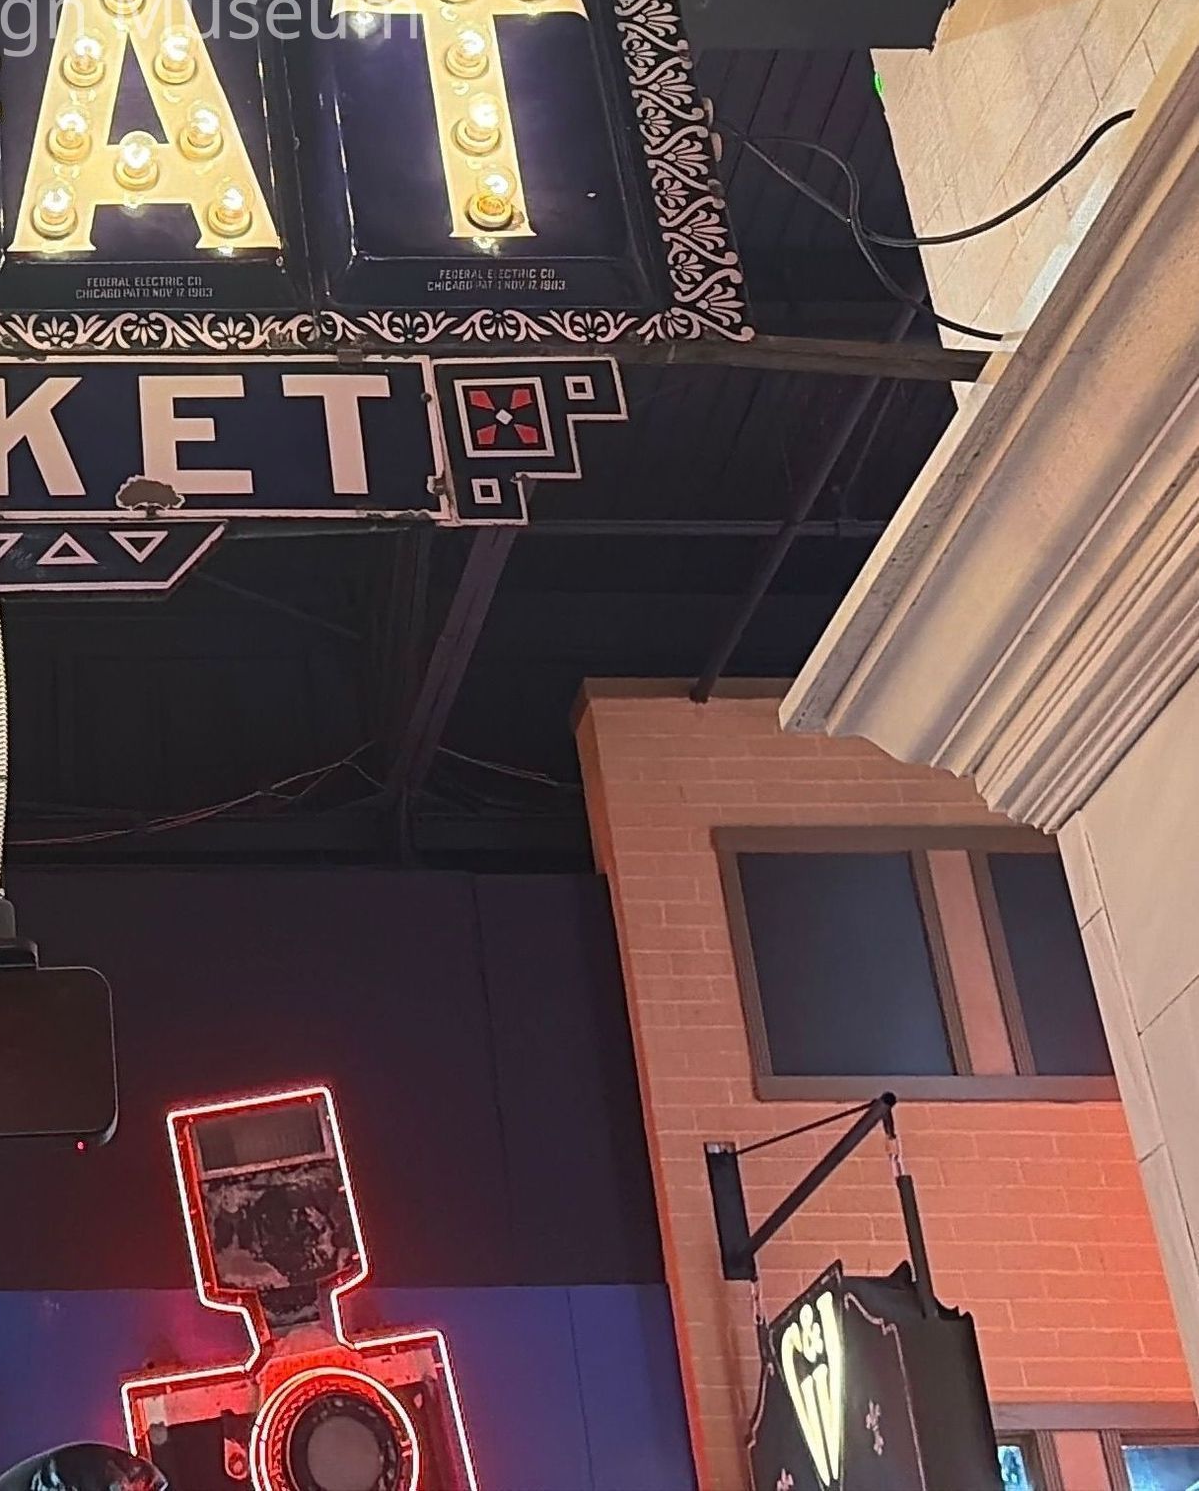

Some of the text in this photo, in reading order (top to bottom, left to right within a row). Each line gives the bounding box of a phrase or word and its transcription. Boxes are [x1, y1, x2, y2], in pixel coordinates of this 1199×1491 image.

[438, 268, 483, 280] FEDERAL
[487, 268, 536, 279] EECTRIC
[86, 276, 131, 288] FEDERAL
[134, 276, 184, 288] ELECTRIC
[427, 280, 473, 292] CHICAGO
[75, 288, 121, 300] CHICAGO
